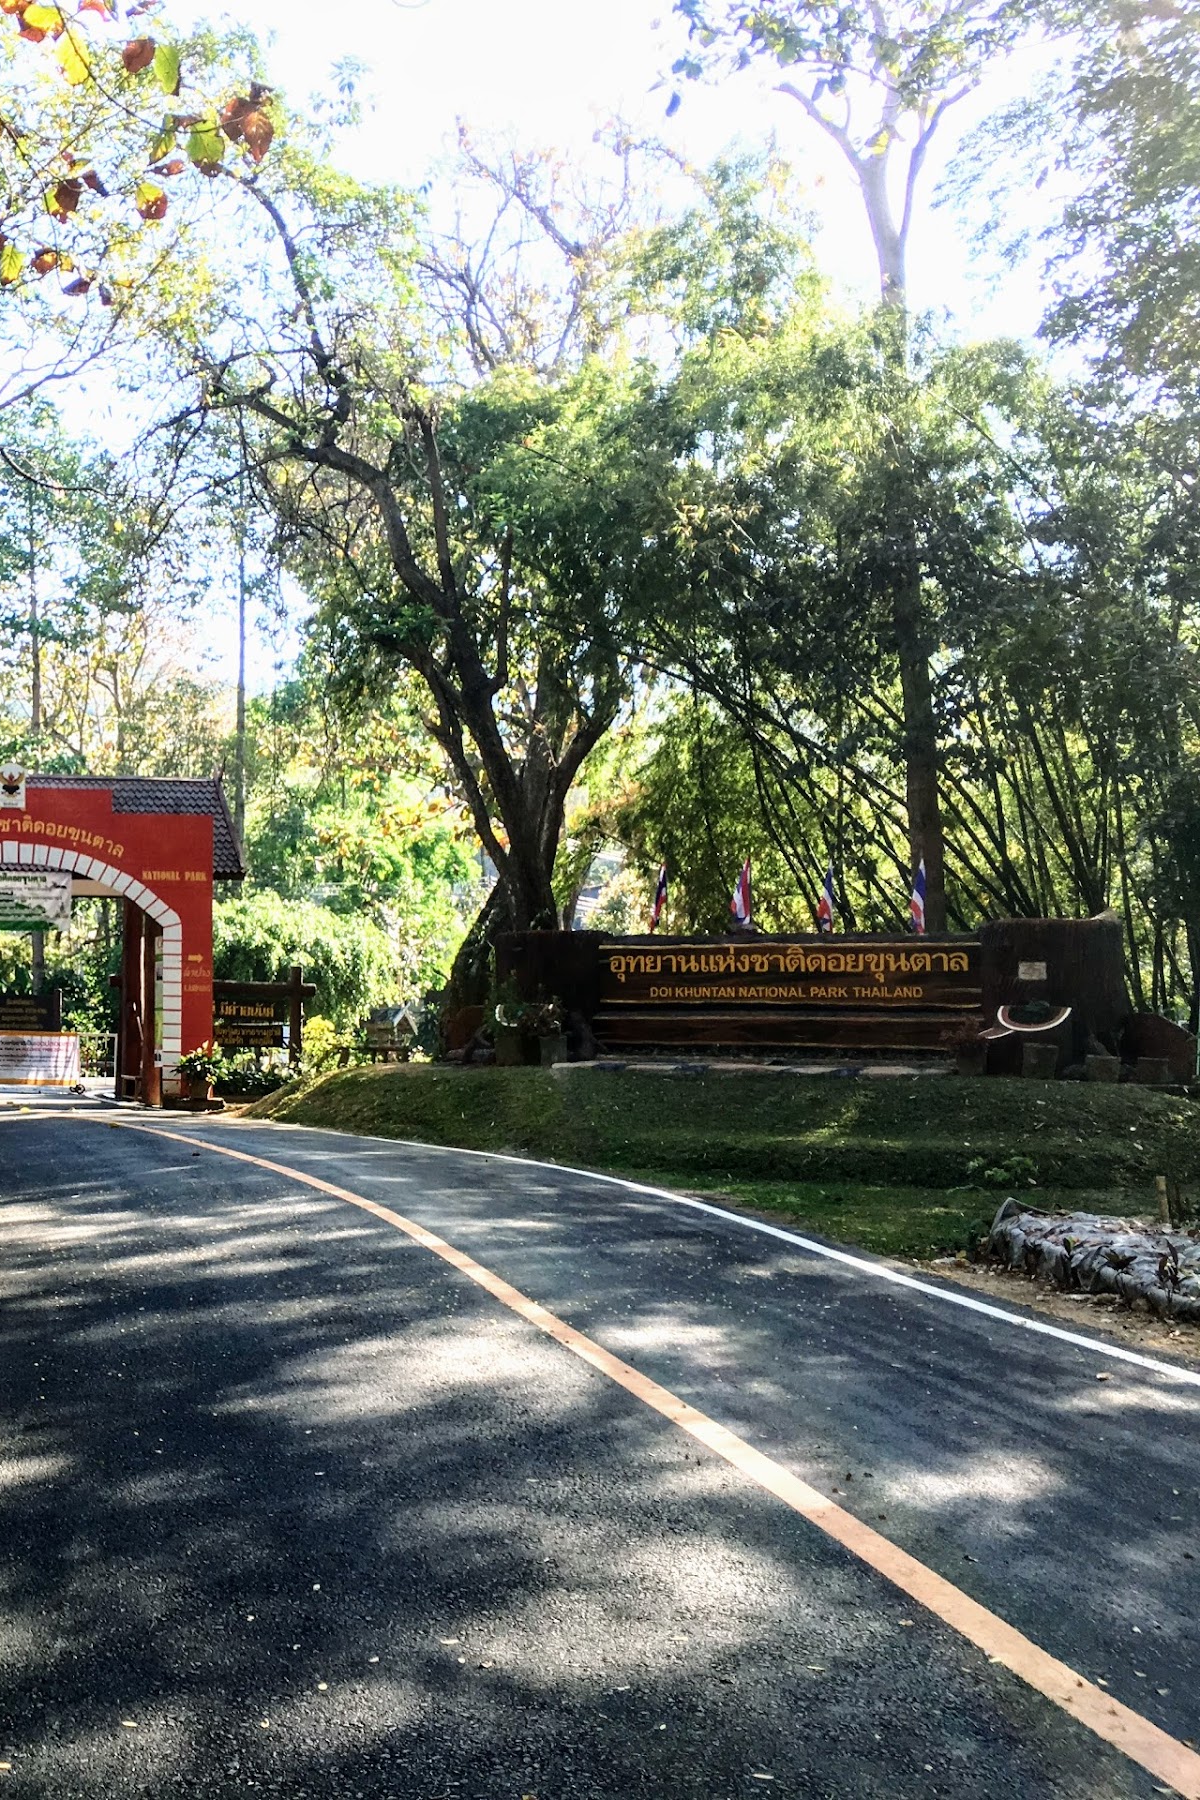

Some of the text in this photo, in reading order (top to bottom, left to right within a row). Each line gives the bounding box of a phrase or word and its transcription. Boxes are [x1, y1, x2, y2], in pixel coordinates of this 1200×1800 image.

[142, 870, 207, 881] NATIONAL PARK
[609, 945, 969, 983] อุทยานแห่งชาติดอยขุนตาล
[650, 986, 923, 998] DOI KHUNTAN NATIONAL PARK THAILAND
